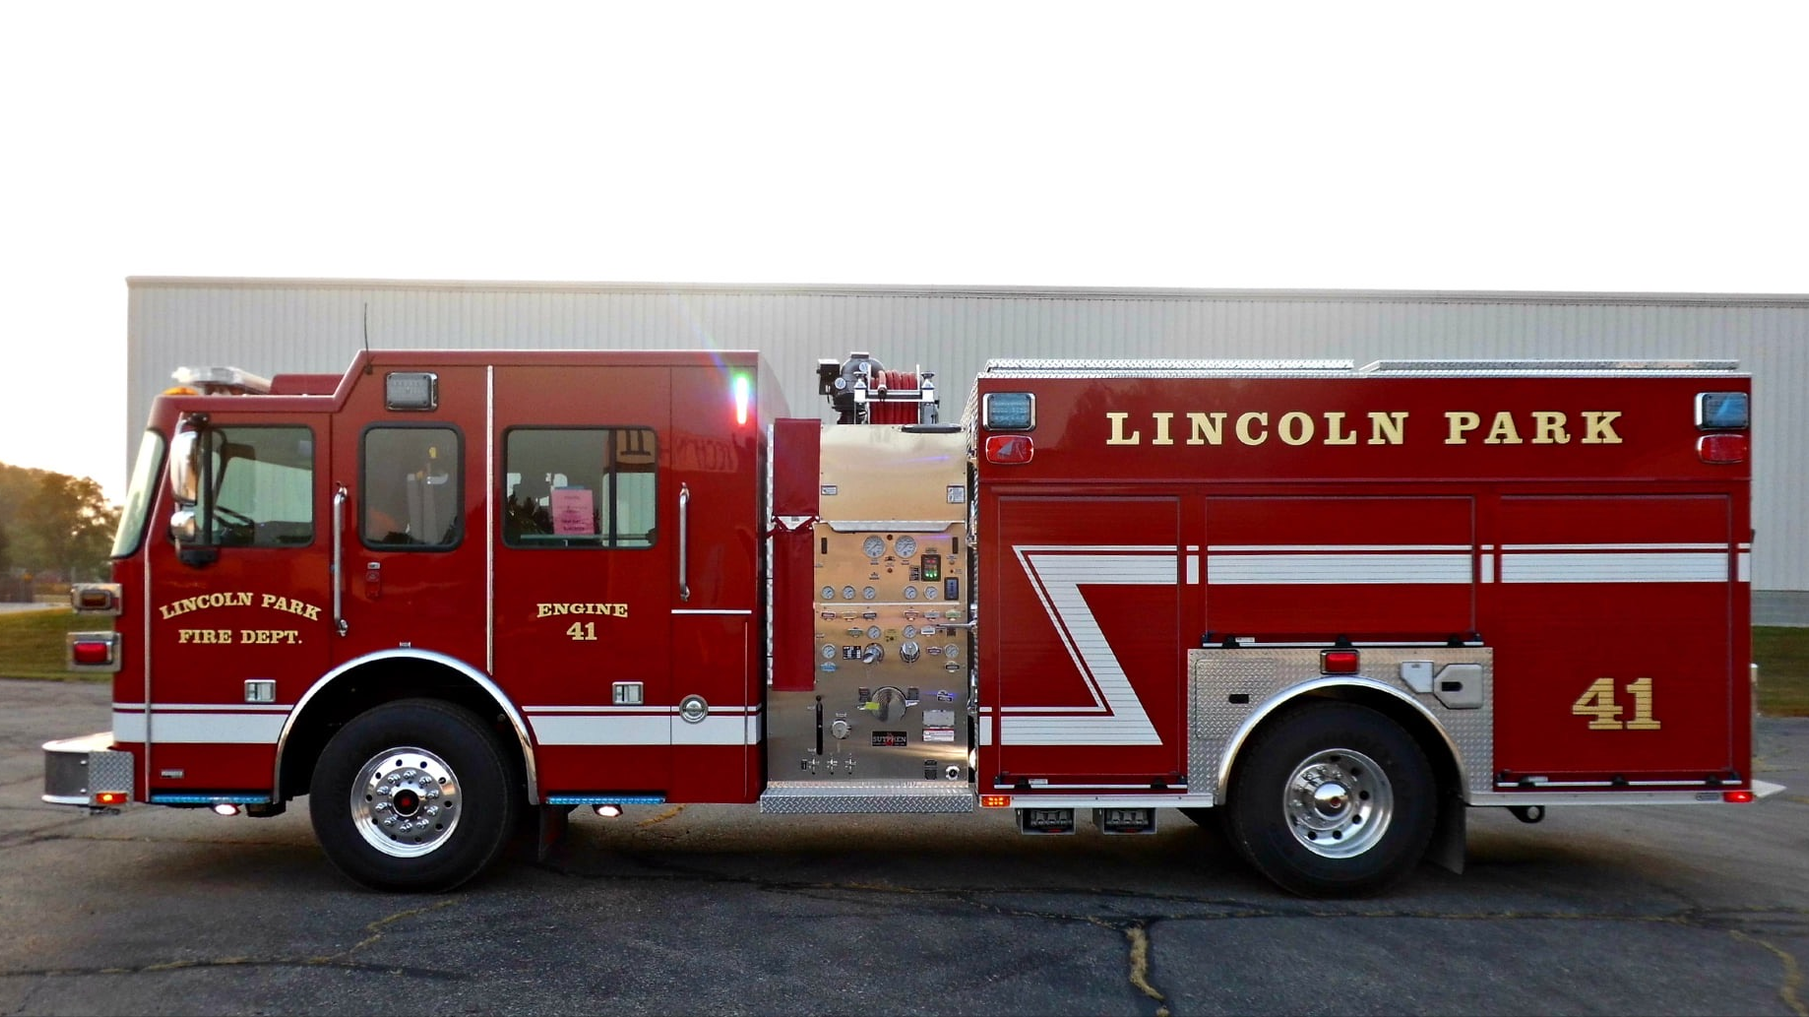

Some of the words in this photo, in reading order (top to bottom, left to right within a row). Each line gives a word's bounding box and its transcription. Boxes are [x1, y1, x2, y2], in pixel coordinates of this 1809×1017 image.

[1105, 411, 1409, 446] LINCOLN
[1444, 411, 1623, 445] PARK
[159, 591, 254, 620] LINCOLN
[261, 593, 322, 621] PARK
[536, 603, 628, 618] ENGINE
[178, 629, 232, 644] FIRE
[240, 629, 303, 644] DEPT.
[566, 621, 598, 641] 41
[1572, 677, 1661, 730] 41
